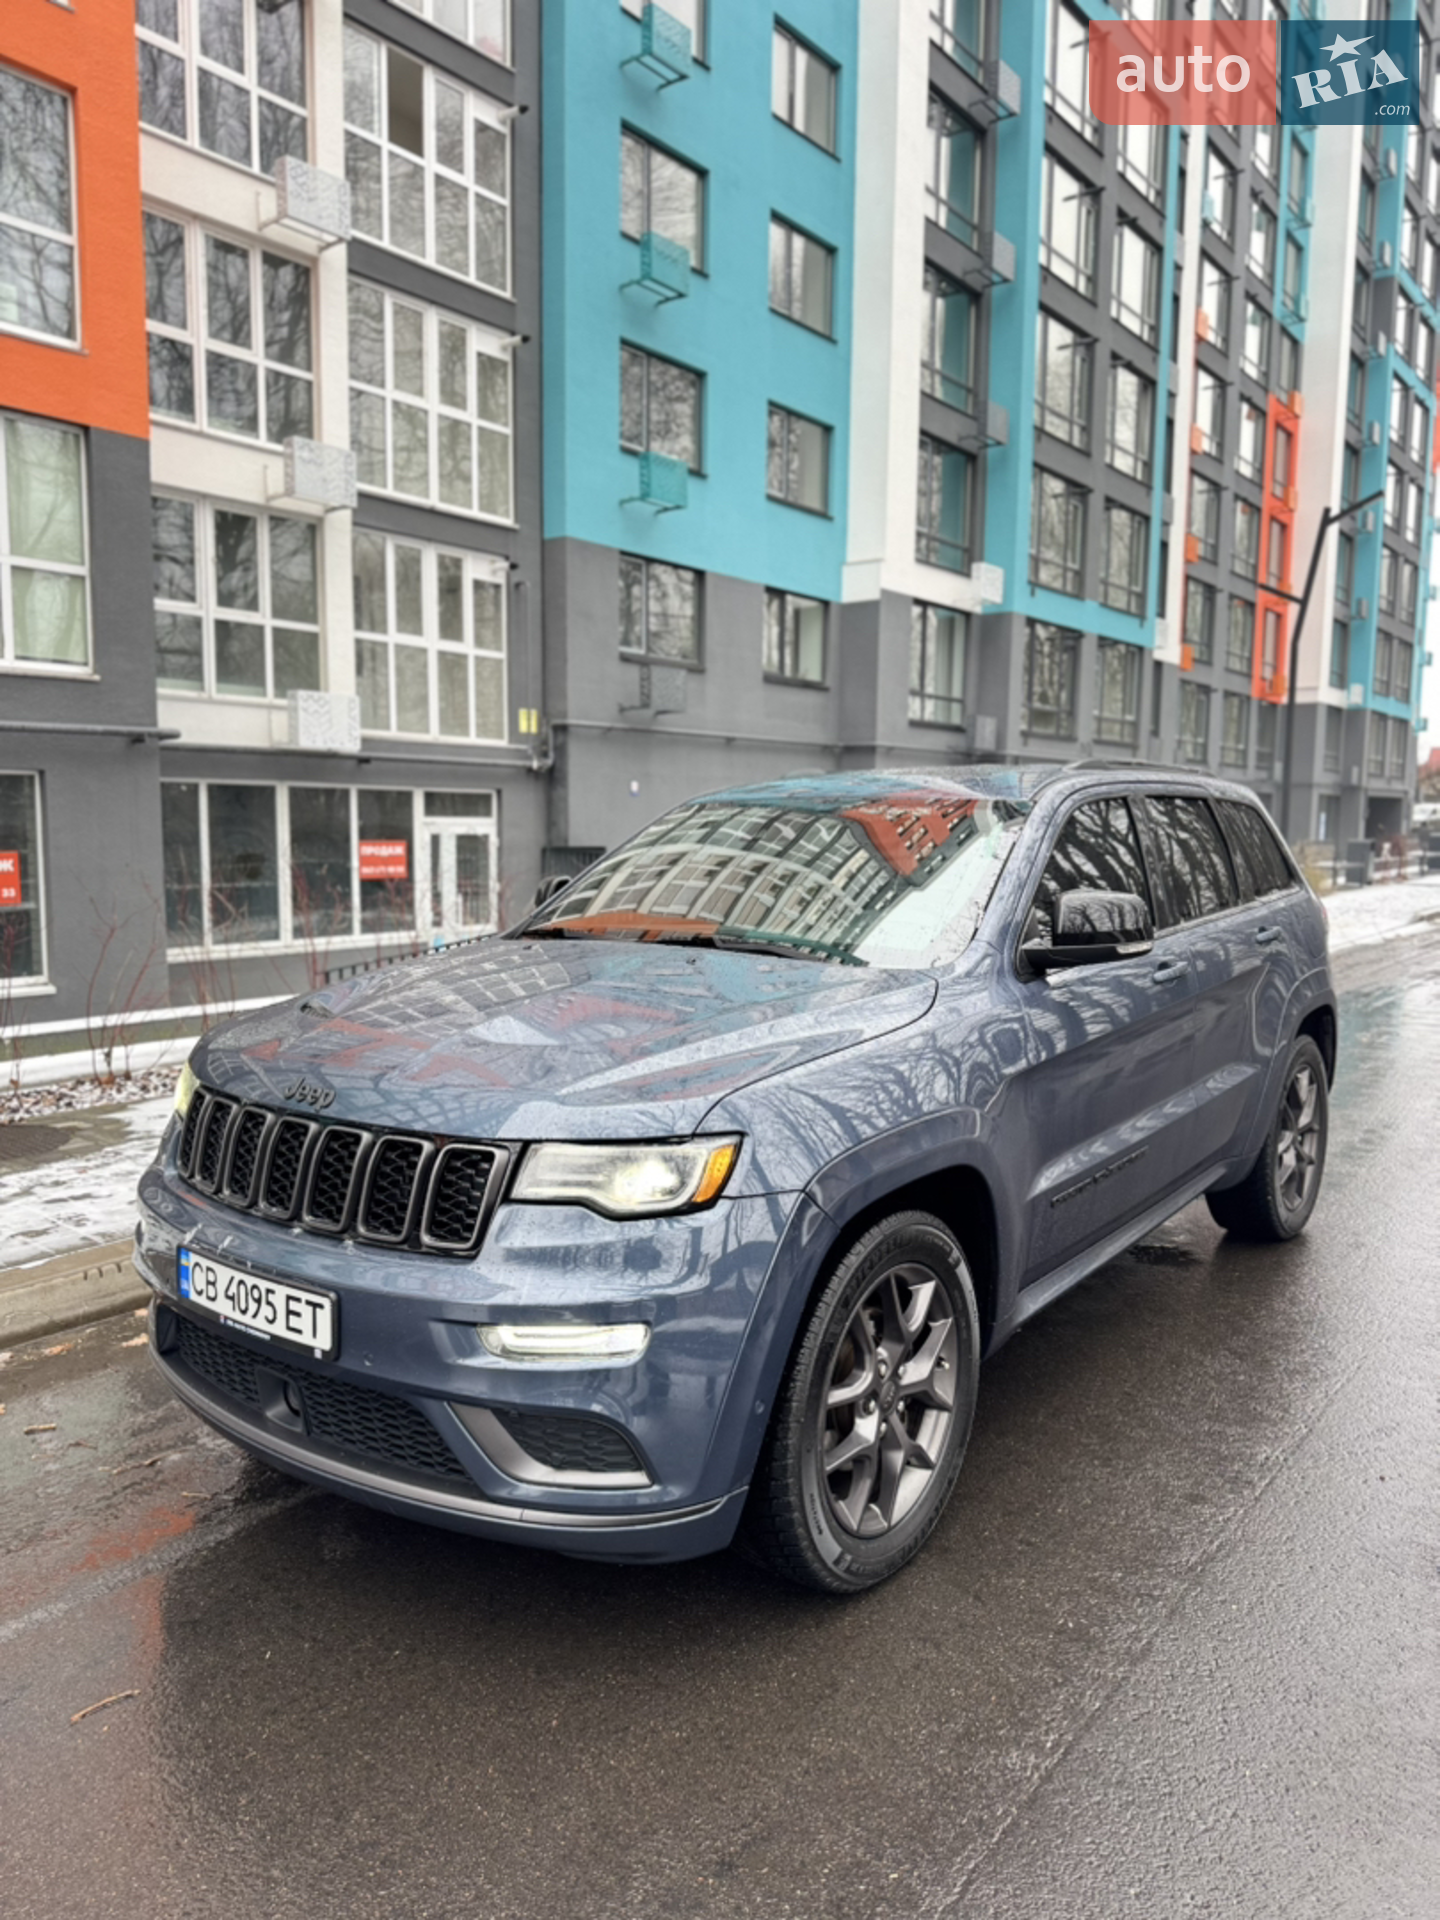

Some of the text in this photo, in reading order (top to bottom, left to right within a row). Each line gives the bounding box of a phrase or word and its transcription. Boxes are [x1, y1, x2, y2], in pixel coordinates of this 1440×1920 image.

[283, 1076, 337, 1113] Jeep
[191, 1261, 218, 1302] CB
[224, 1275, 278, 1325] 4095
[285, 1293, 325, 1340] ET
